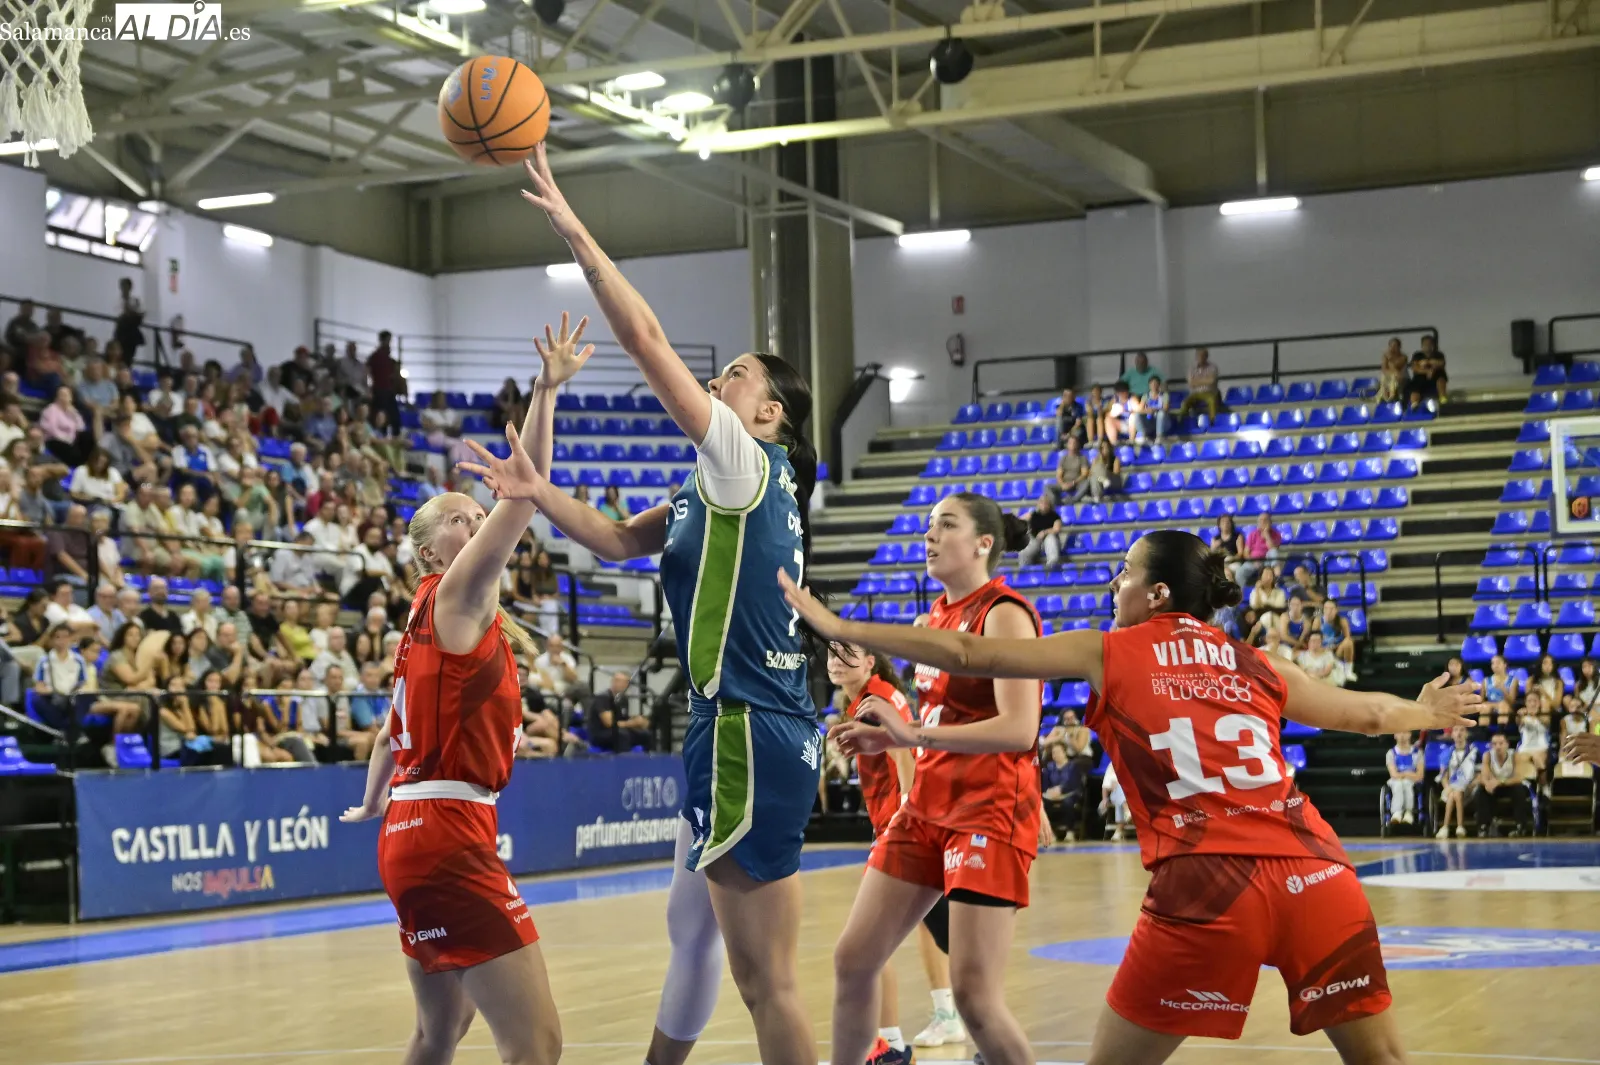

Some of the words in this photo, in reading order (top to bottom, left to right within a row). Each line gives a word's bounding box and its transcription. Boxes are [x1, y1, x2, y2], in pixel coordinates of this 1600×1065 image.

[1153, 686, 1168, 695] DE
[1169, 685, 1221, 701] LUGO
[1148, 713, 1283, 801] 13
[111, 822, 235, 864] CASTILLA
[244, 819, 261, 864] Y
[267, 805, 329, 853] LEÓN
[172, 871, 203, 893] NOS
[1303, 870, 1326, 886] NEW
[417, 926, 448, 941] GWM
[1325, 974, 1371, 996] GWM
